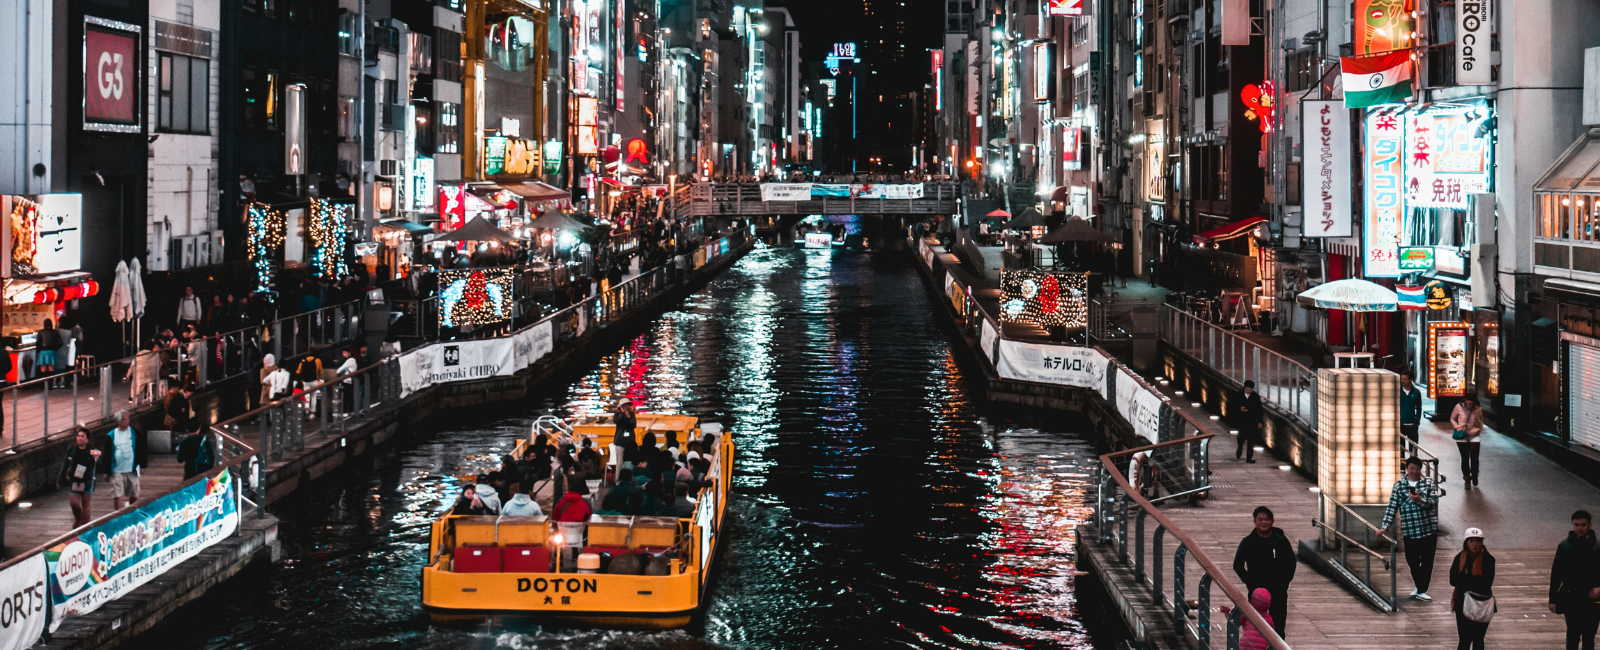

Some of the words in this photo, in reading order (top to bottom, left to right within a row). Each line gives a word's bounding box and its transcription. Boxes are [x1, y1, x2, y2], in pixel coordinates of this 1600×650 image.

[1463, 0, 1480, 32] RO
[98, 51, 123, 100] G3
[1320, 104, 1334, 232] よしもとエンタメショップ
[1375, 138, 1397, 207] ダイコク
[1432, 178, 1462, 203] 免税
[469, 364, 500, 377] CHIBO
[60, 548, 90, 578] WAON
[517, 577, 597, 593] DOTON
[543, 595, 571, 605] 大阪
